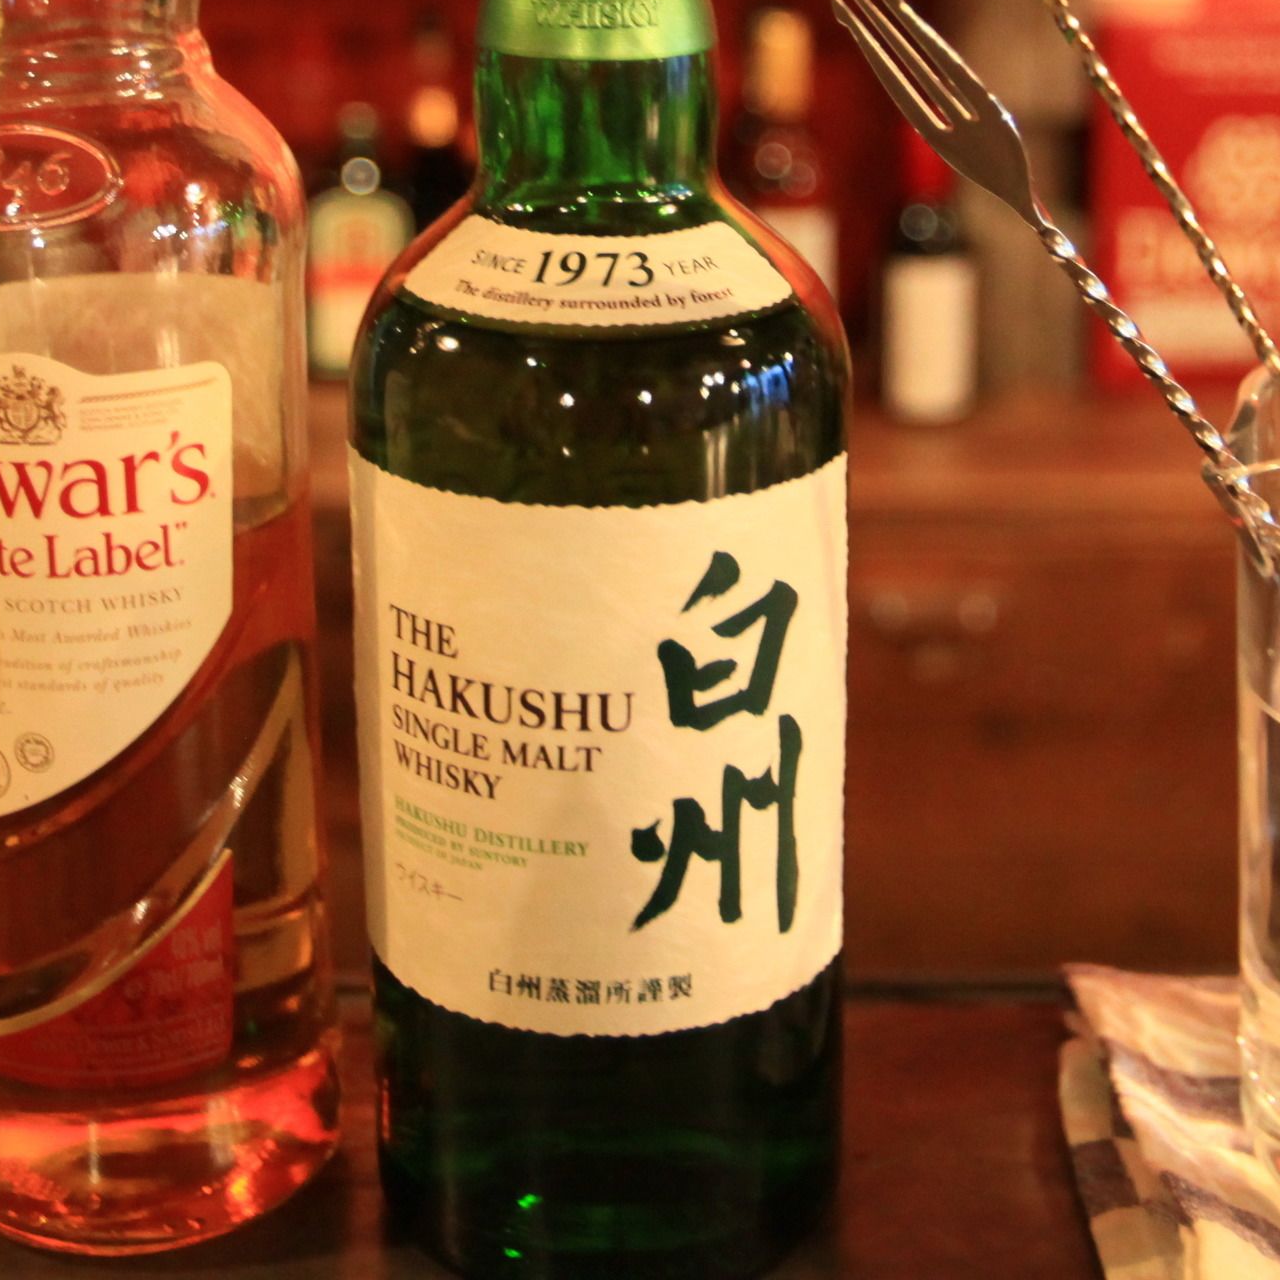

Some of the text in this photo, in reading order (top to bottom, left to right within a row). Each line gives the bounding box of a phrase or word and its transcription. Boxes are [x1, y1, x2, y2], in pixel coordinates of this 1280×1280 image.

[455, 279, 480, 296] The
[481, 285, 553, 312] distillery
[559, 293, 662, 310] surrounded
[663, 291, 686, 310] by
[470, 249, 720, 288] SINCE 1973 YEAR
[4, 598, 93, 615] SCOTCH
[100, 586, 183, 611] WHISKY
[390, 603, 459, 659] THE
[391, 651, 635, 733] HAKUSHU
[392, 704, 602, 773] SINGLE MALT
[630, 550, 803, 935] 白州
[393, 738, 502, 801] WHISKY
[394, 795, 589, 857] HAKUSHU DISTILLERY
[468, 846, 529, 869] SUNTORY
